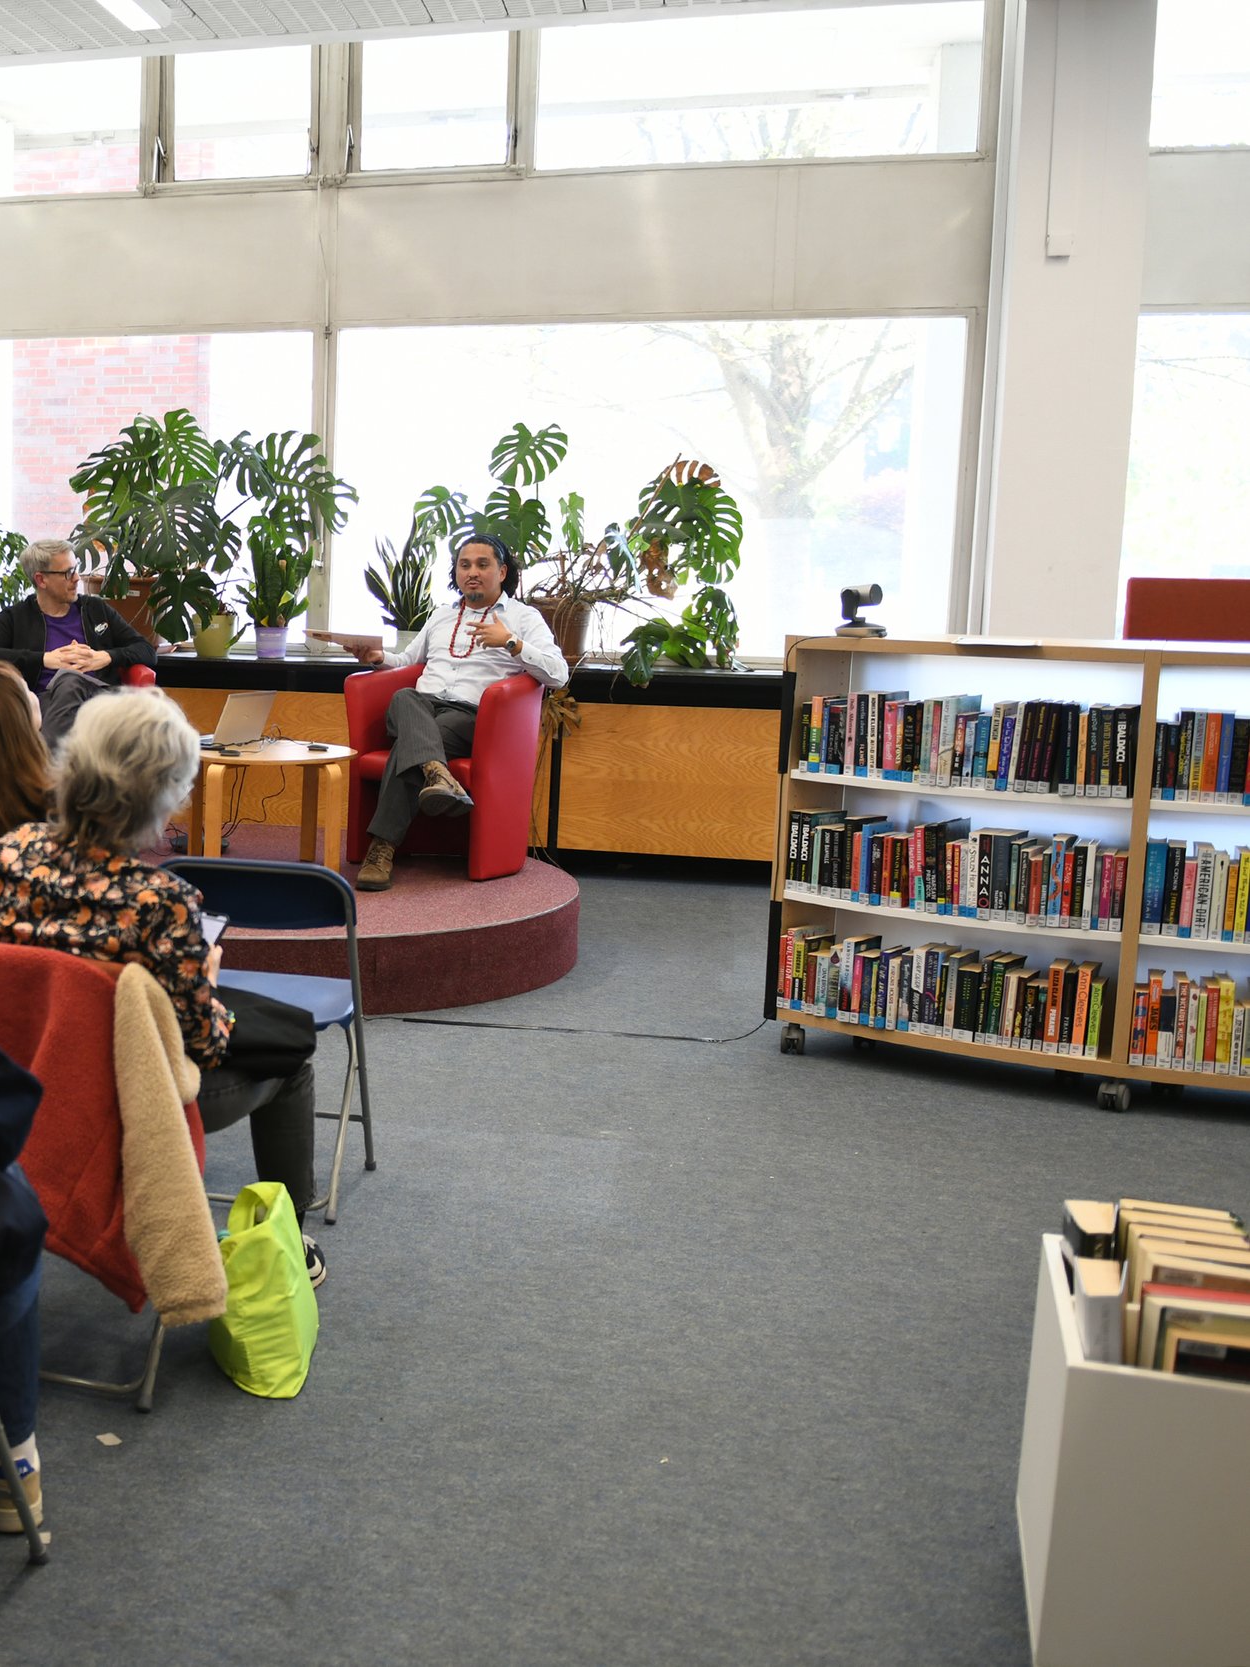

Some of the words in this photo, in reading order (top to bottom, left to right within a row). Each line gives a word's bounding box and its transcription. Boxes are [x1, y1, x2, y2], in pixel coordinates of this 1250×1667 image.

[1102, 740, 1110, 766] BALDACCI
[1116, 724, 1127, 762] BALDACCI
[1179, 732, 1187, 753] Harlan
[1192, 756, 1202, 781] JONATHAN
[789, 825, 799, 859] BALDACCI
[800, 827, 810, 861] BALDACCI
[968, 849, 977, 873] STOLEN
[1154, 863, 1162, 882] JUSTIN
[979, 856, 990, 896] ANNA
[1197, 859, 1211, 905] AMERICAN
[1239, 878, 1248, 891] Thing
[1194, 908, 1207, 928] DIRT
[785, 930, 794, 979] DEVOLUTION
[842, 964, 850, 987] BROWN
[1052, 970, 1060, 986] ELIZA
[1079, 970, 1088, 990] Ann
[994, 986, 1002, 1007] CHILD
[1051, 987, 1059, 1007] CLARK
[1180, 985, 1188, 996] THE
[1047, 1008, 1057, 1036] PENANCE
[1075, 991, 1087, 1028] Cleeves
[1090, 1003, 1099, 1033] Cleeves
[1149, 1006, 1159, 1031] JAMES
[1178, 998, 1187, 1026] DICTATOR'S
[1062, 1017, 1070, 1042] PIRANES
[1176, 1028, 1184, 1042] MUSE
